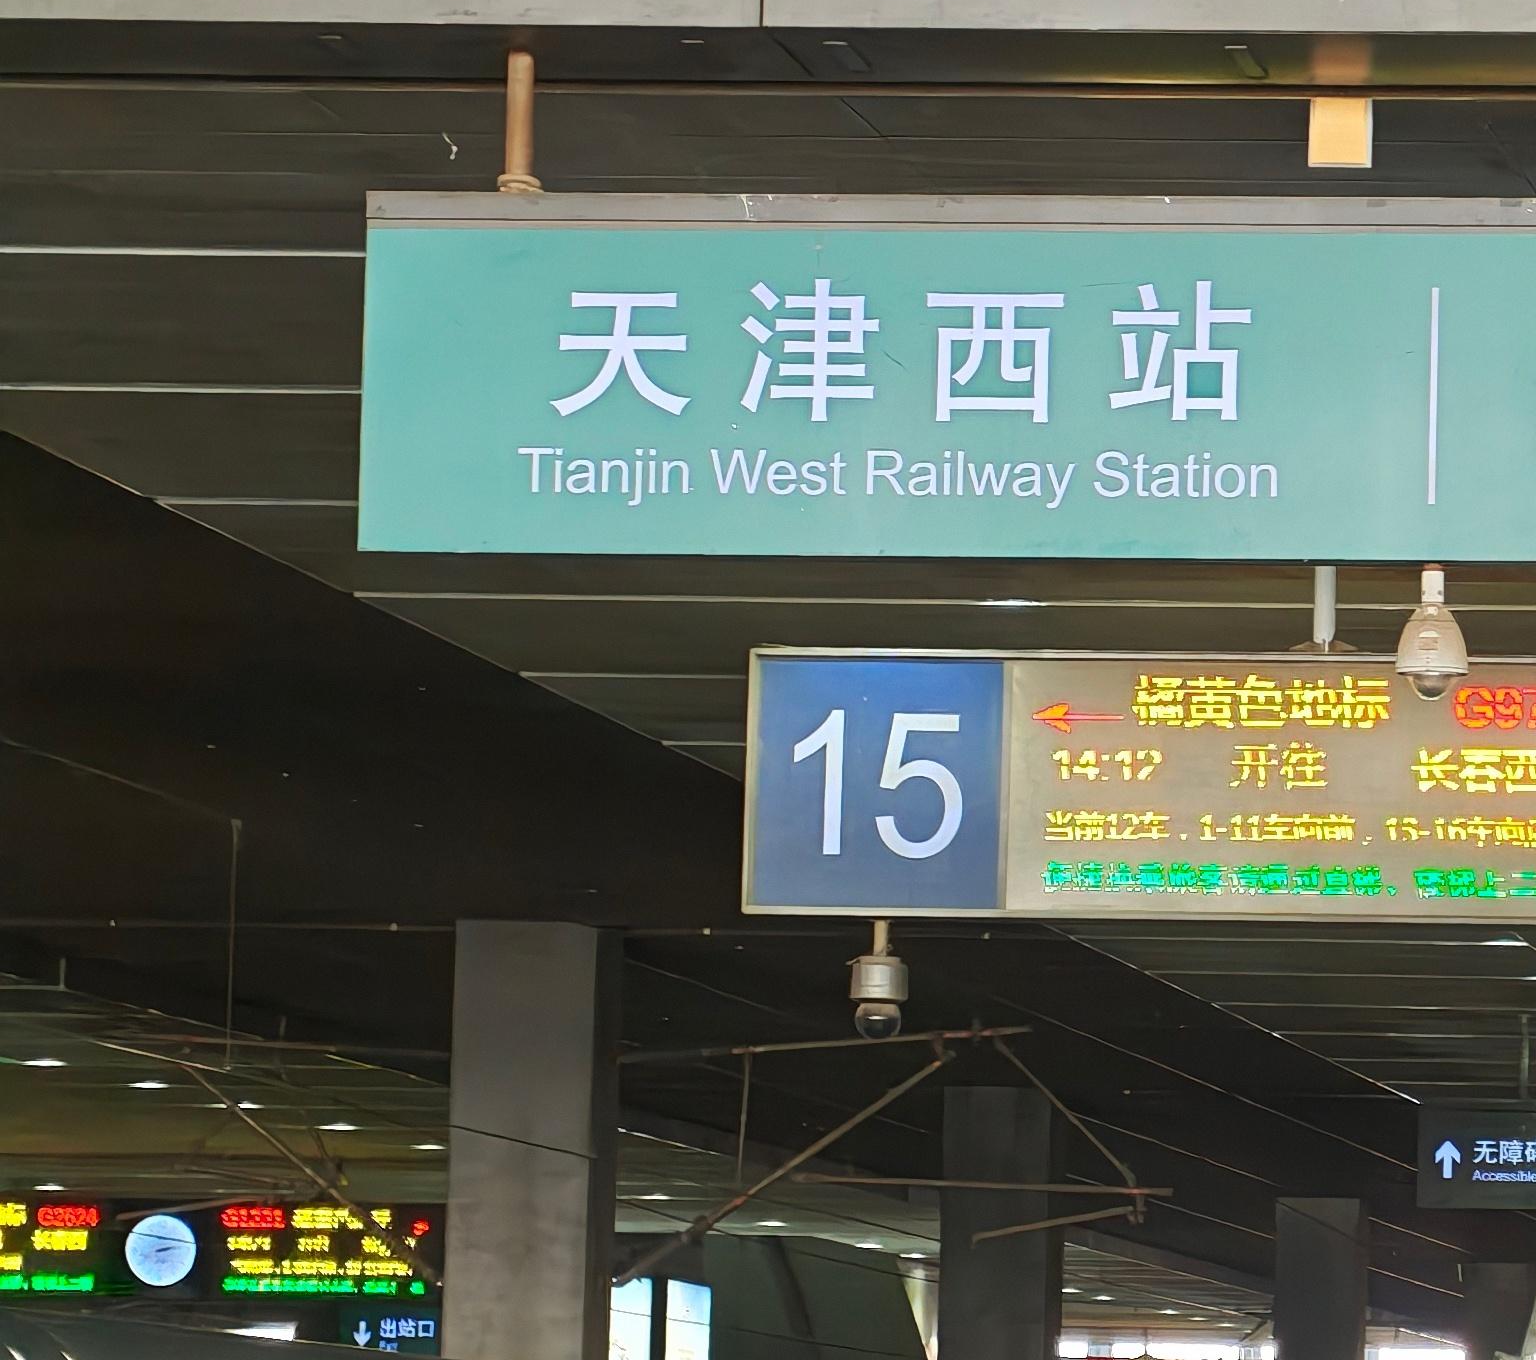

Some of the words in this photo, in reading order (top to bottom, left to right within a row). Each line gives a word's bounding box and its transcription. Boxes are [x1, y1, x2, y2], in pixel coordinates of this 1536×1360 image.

[551, 278, 1252, 424] 天津西站
[517, 446, 690, 506] Tianjin
[710, 448, 848, 497] West
[865, 450, 1077, 510] Railway
[1093, 451, 1280, 499] Station
[792, 708, 965, 860] 15
[1230, 742, 1328, 790] 开往
[379, 1317, 435, 1339] 出站口
